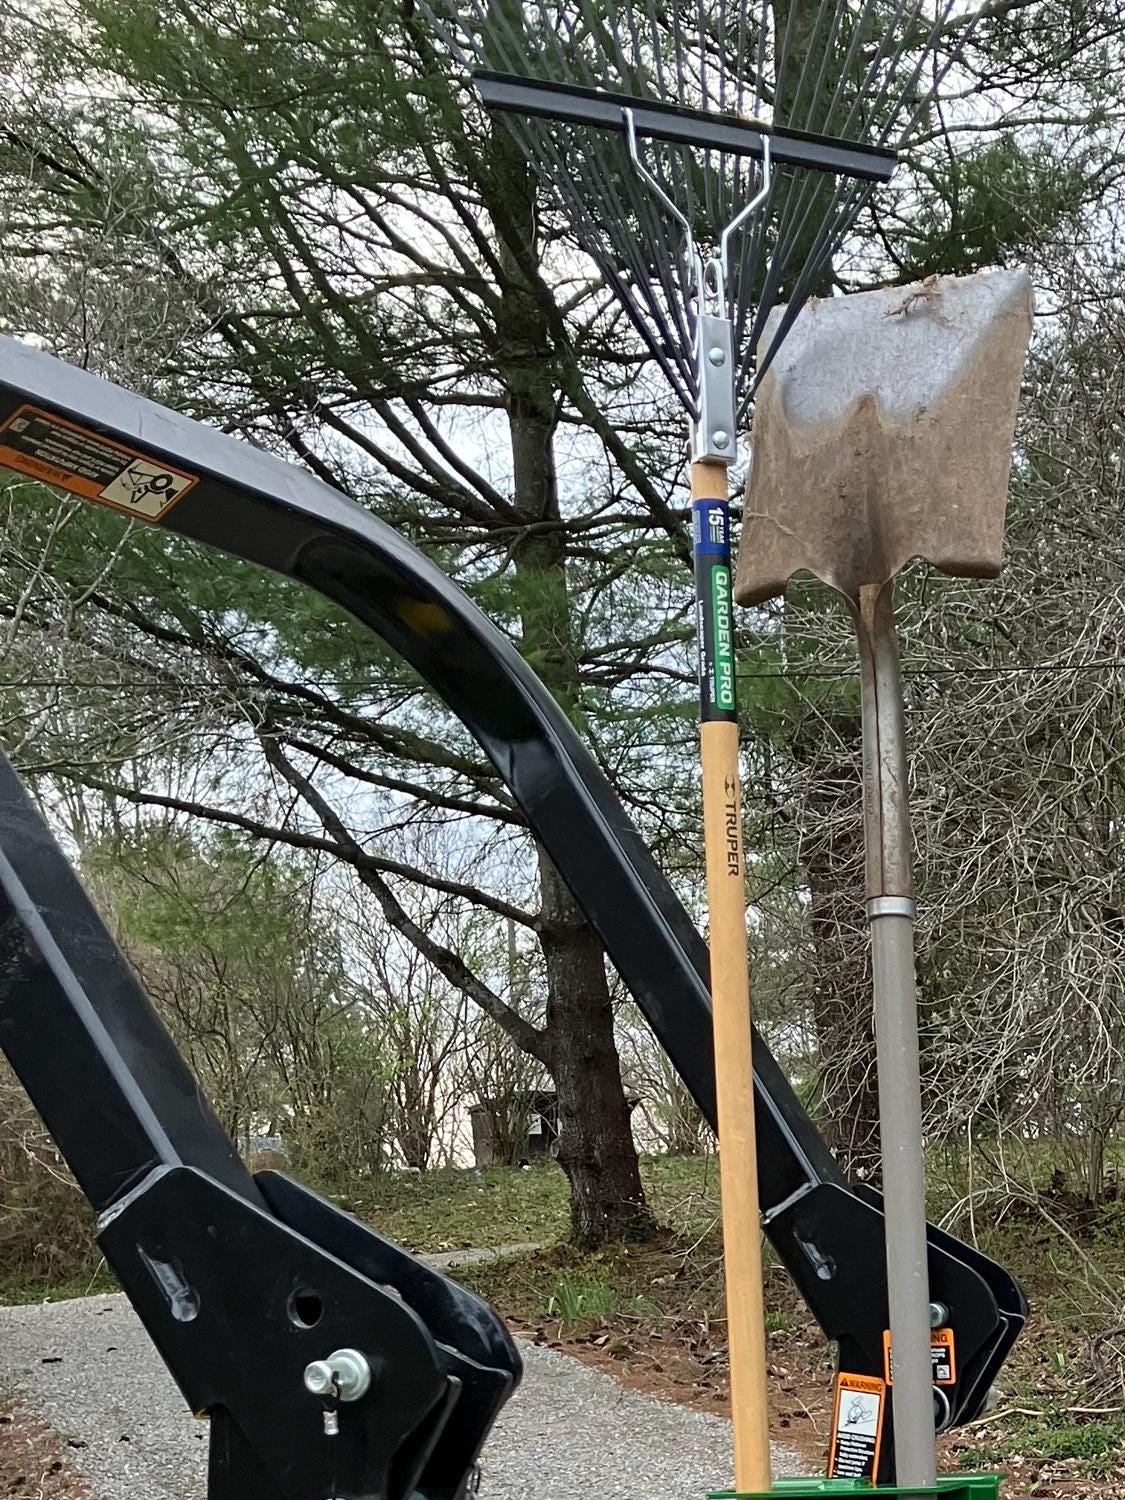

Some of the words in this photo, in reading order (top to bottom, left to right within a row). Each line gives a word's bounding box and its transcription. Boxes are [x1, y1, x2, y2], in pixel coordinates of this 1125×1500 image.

[708, 507, 724, 526] 15
[716, 572, 730, 657] GARDEN
[719, 661, 733, 704] PRO
[725, 801, 739, 877] TRUPER
